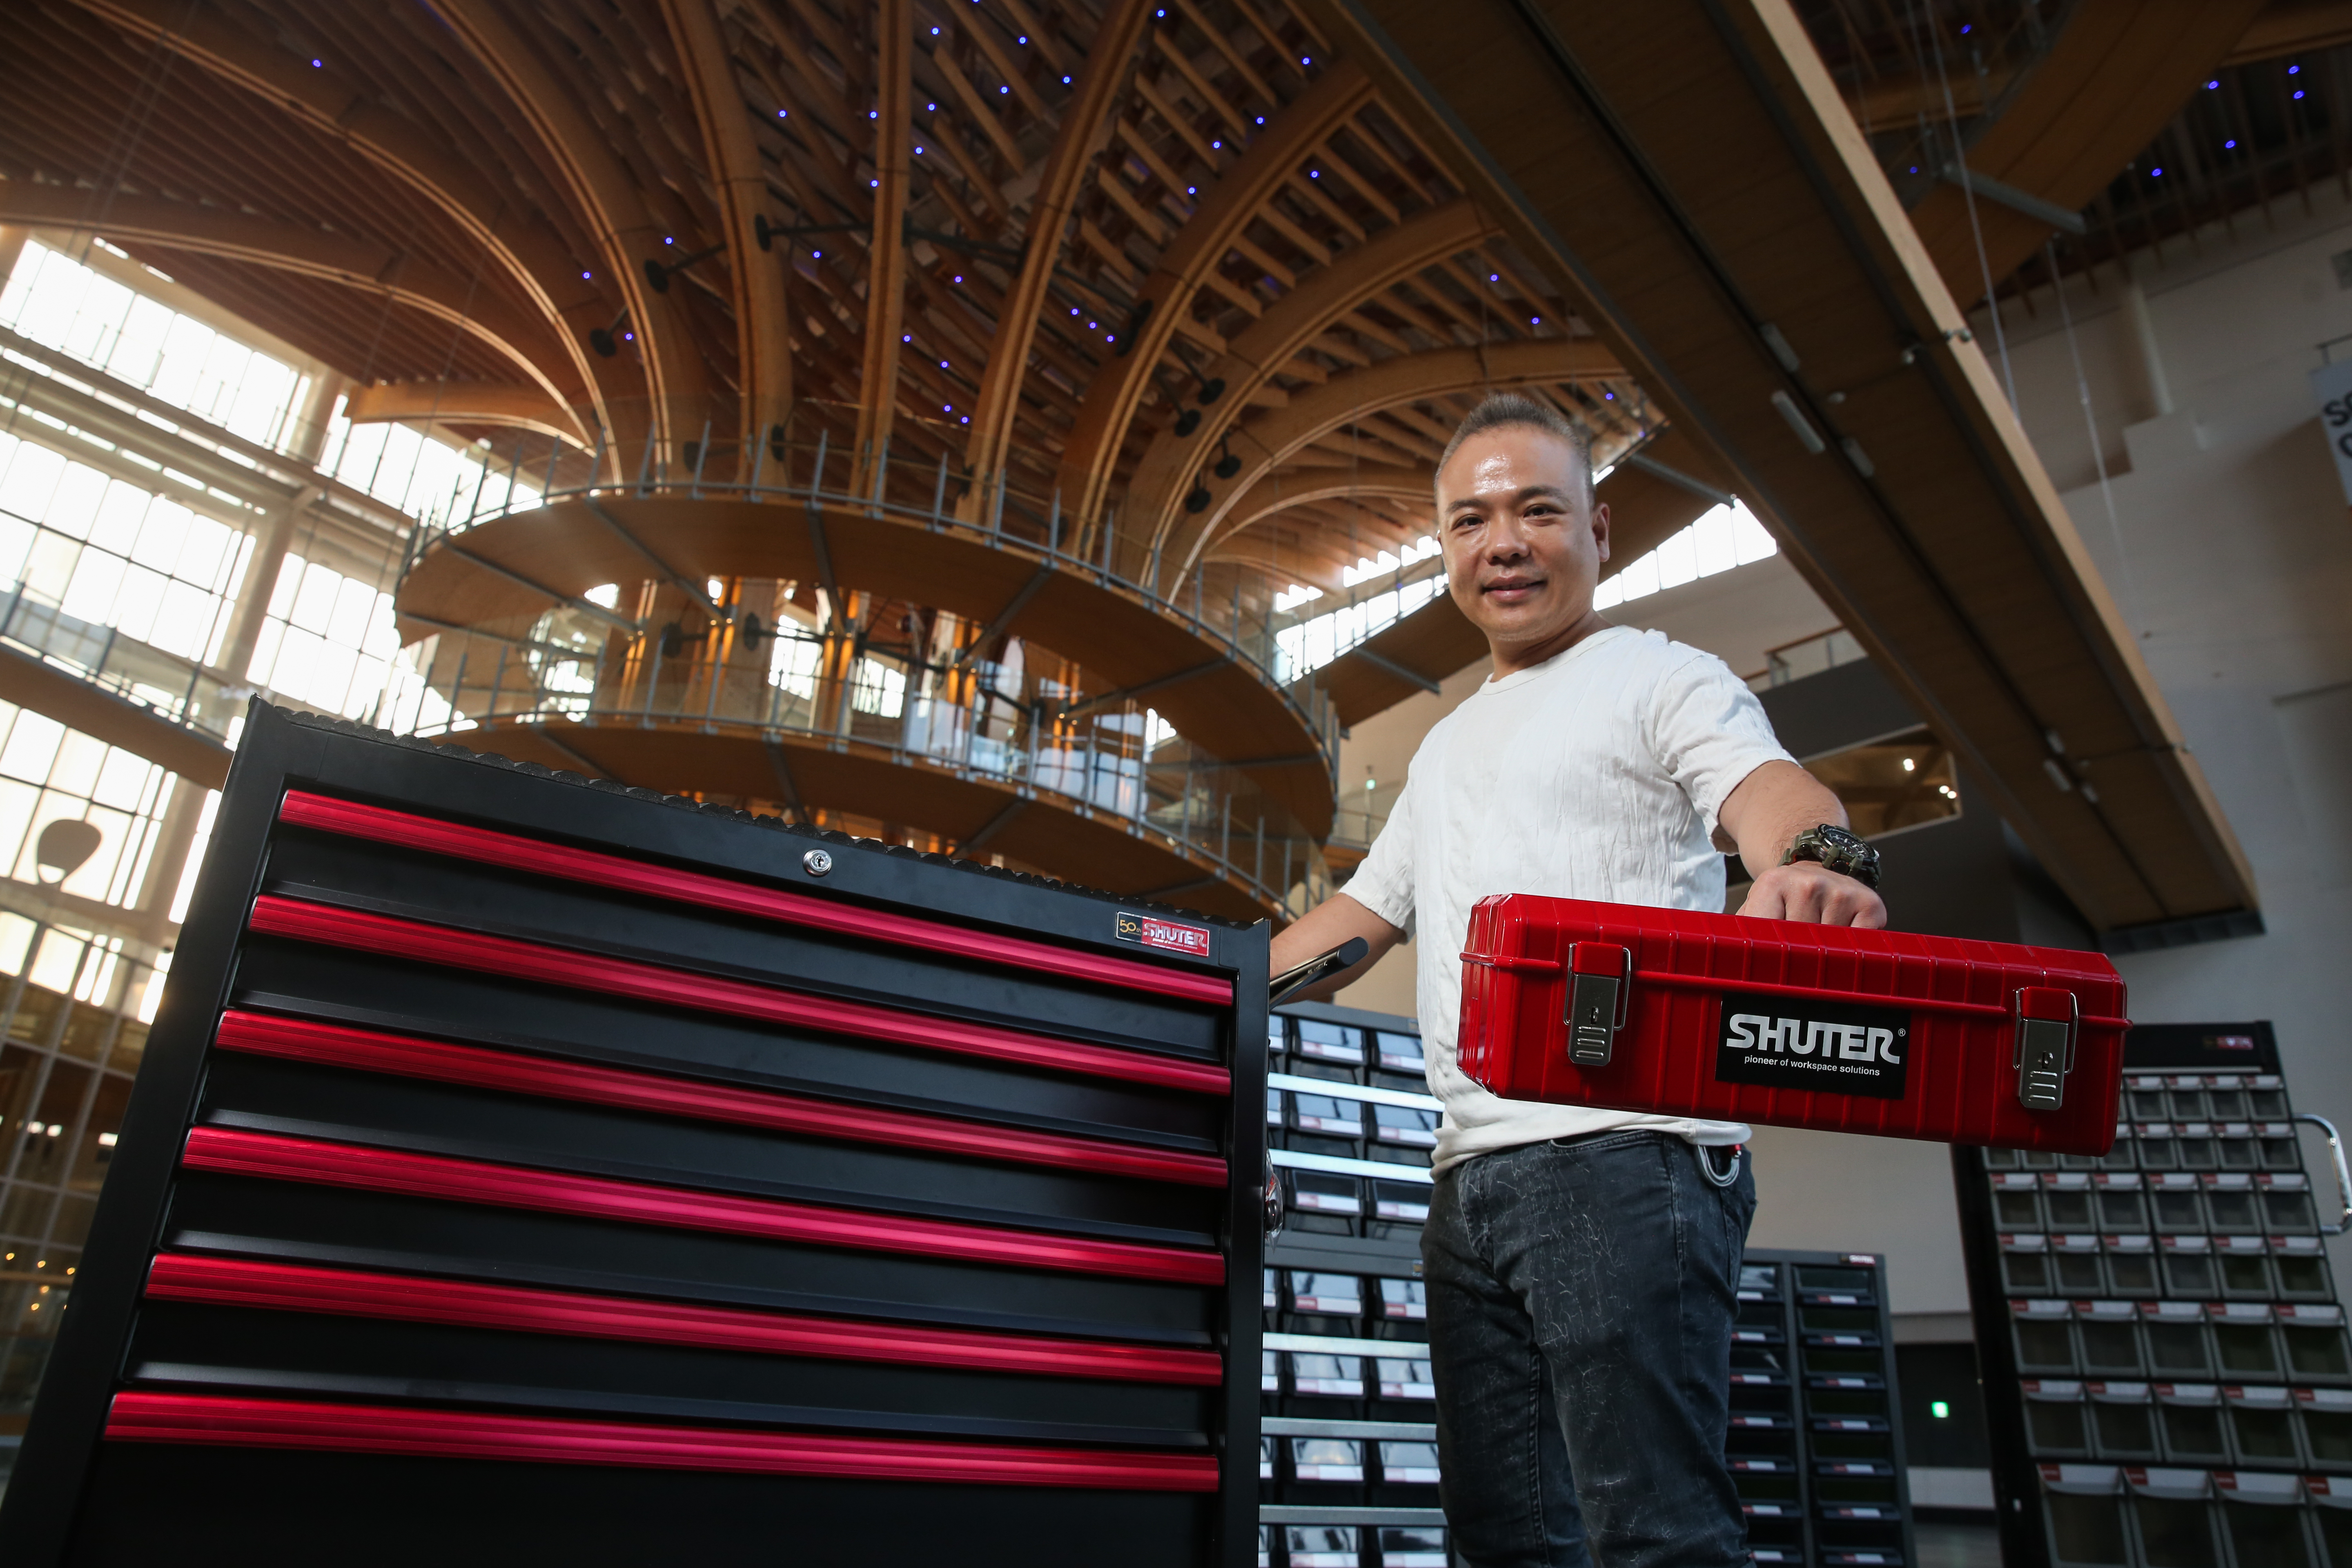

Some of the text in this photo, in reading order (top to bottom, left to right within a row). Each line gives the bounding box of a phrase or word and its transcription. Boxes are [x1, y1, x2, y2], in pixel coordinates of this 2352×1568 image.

[1143, 922, 1207, 948] SHUTER
[1744, 1056, 1778, 1065] pioneer
[1791, 1061, 1838, 1071] workspace
[1840, 1065, 1880, 1076] solutions
